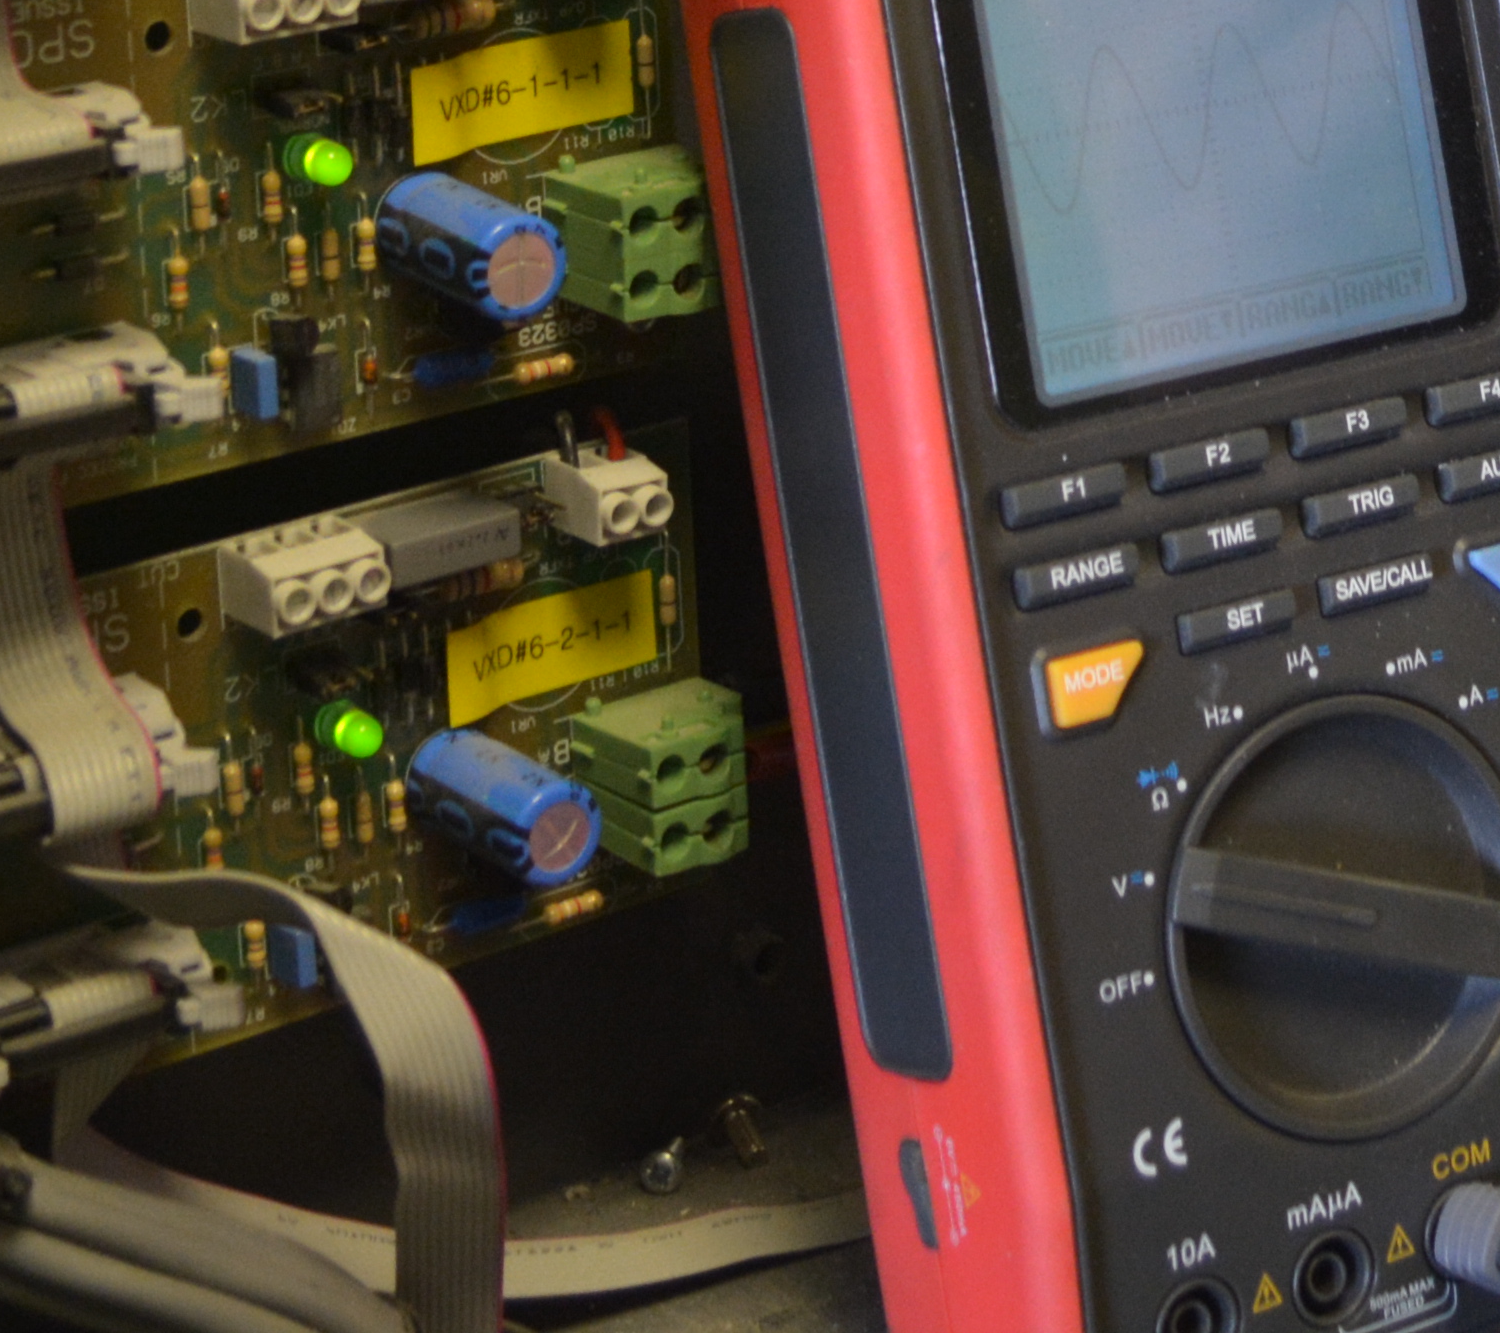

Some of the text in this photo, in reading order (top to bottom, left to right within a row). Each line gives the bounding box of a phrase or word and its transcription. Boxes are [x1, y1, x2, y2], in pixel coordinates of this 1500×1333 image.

[439, 61, 600, 123] VXD#6-1-1-1
[563, 133, 590, 150] R11
[608, 125, 635, 142] R10
[1046, 339, 1124, 374] MOVE
[1150, 312, 1221, 350] MOVE
[1346, 410, 1370, 433] F3
[1206, 444, 1231, 467] F2
[1061, 477, 1087, 502] F1
[1348, 487, 1395, 515] TRIG
[1208, 521, 1256, 550] TIME
[138, 559, 180, 588] CUT
[1051, 553, 1125, 589] RANGE
[1335, 559, 1432, 602] SAVE/CALL
[1227, 603, 1264, 631] SET
[473, 611, 631, 681] VXD#6-2-1-1
[633, 660, 658, 679] R10
[1396, 648, 1429, 674] mA
[1064, 659, 1125, 693] MODE
[1470, 685, 1485, 707] A
[1204, 703, 1231, 729] Hz
[1112, 876, 1128, 898] V
[1099, 974, 1143, 1003] OFF
[1432, 1139, 1491, 1181] COM
[1167, 1233, 1216, 1271] 10A
